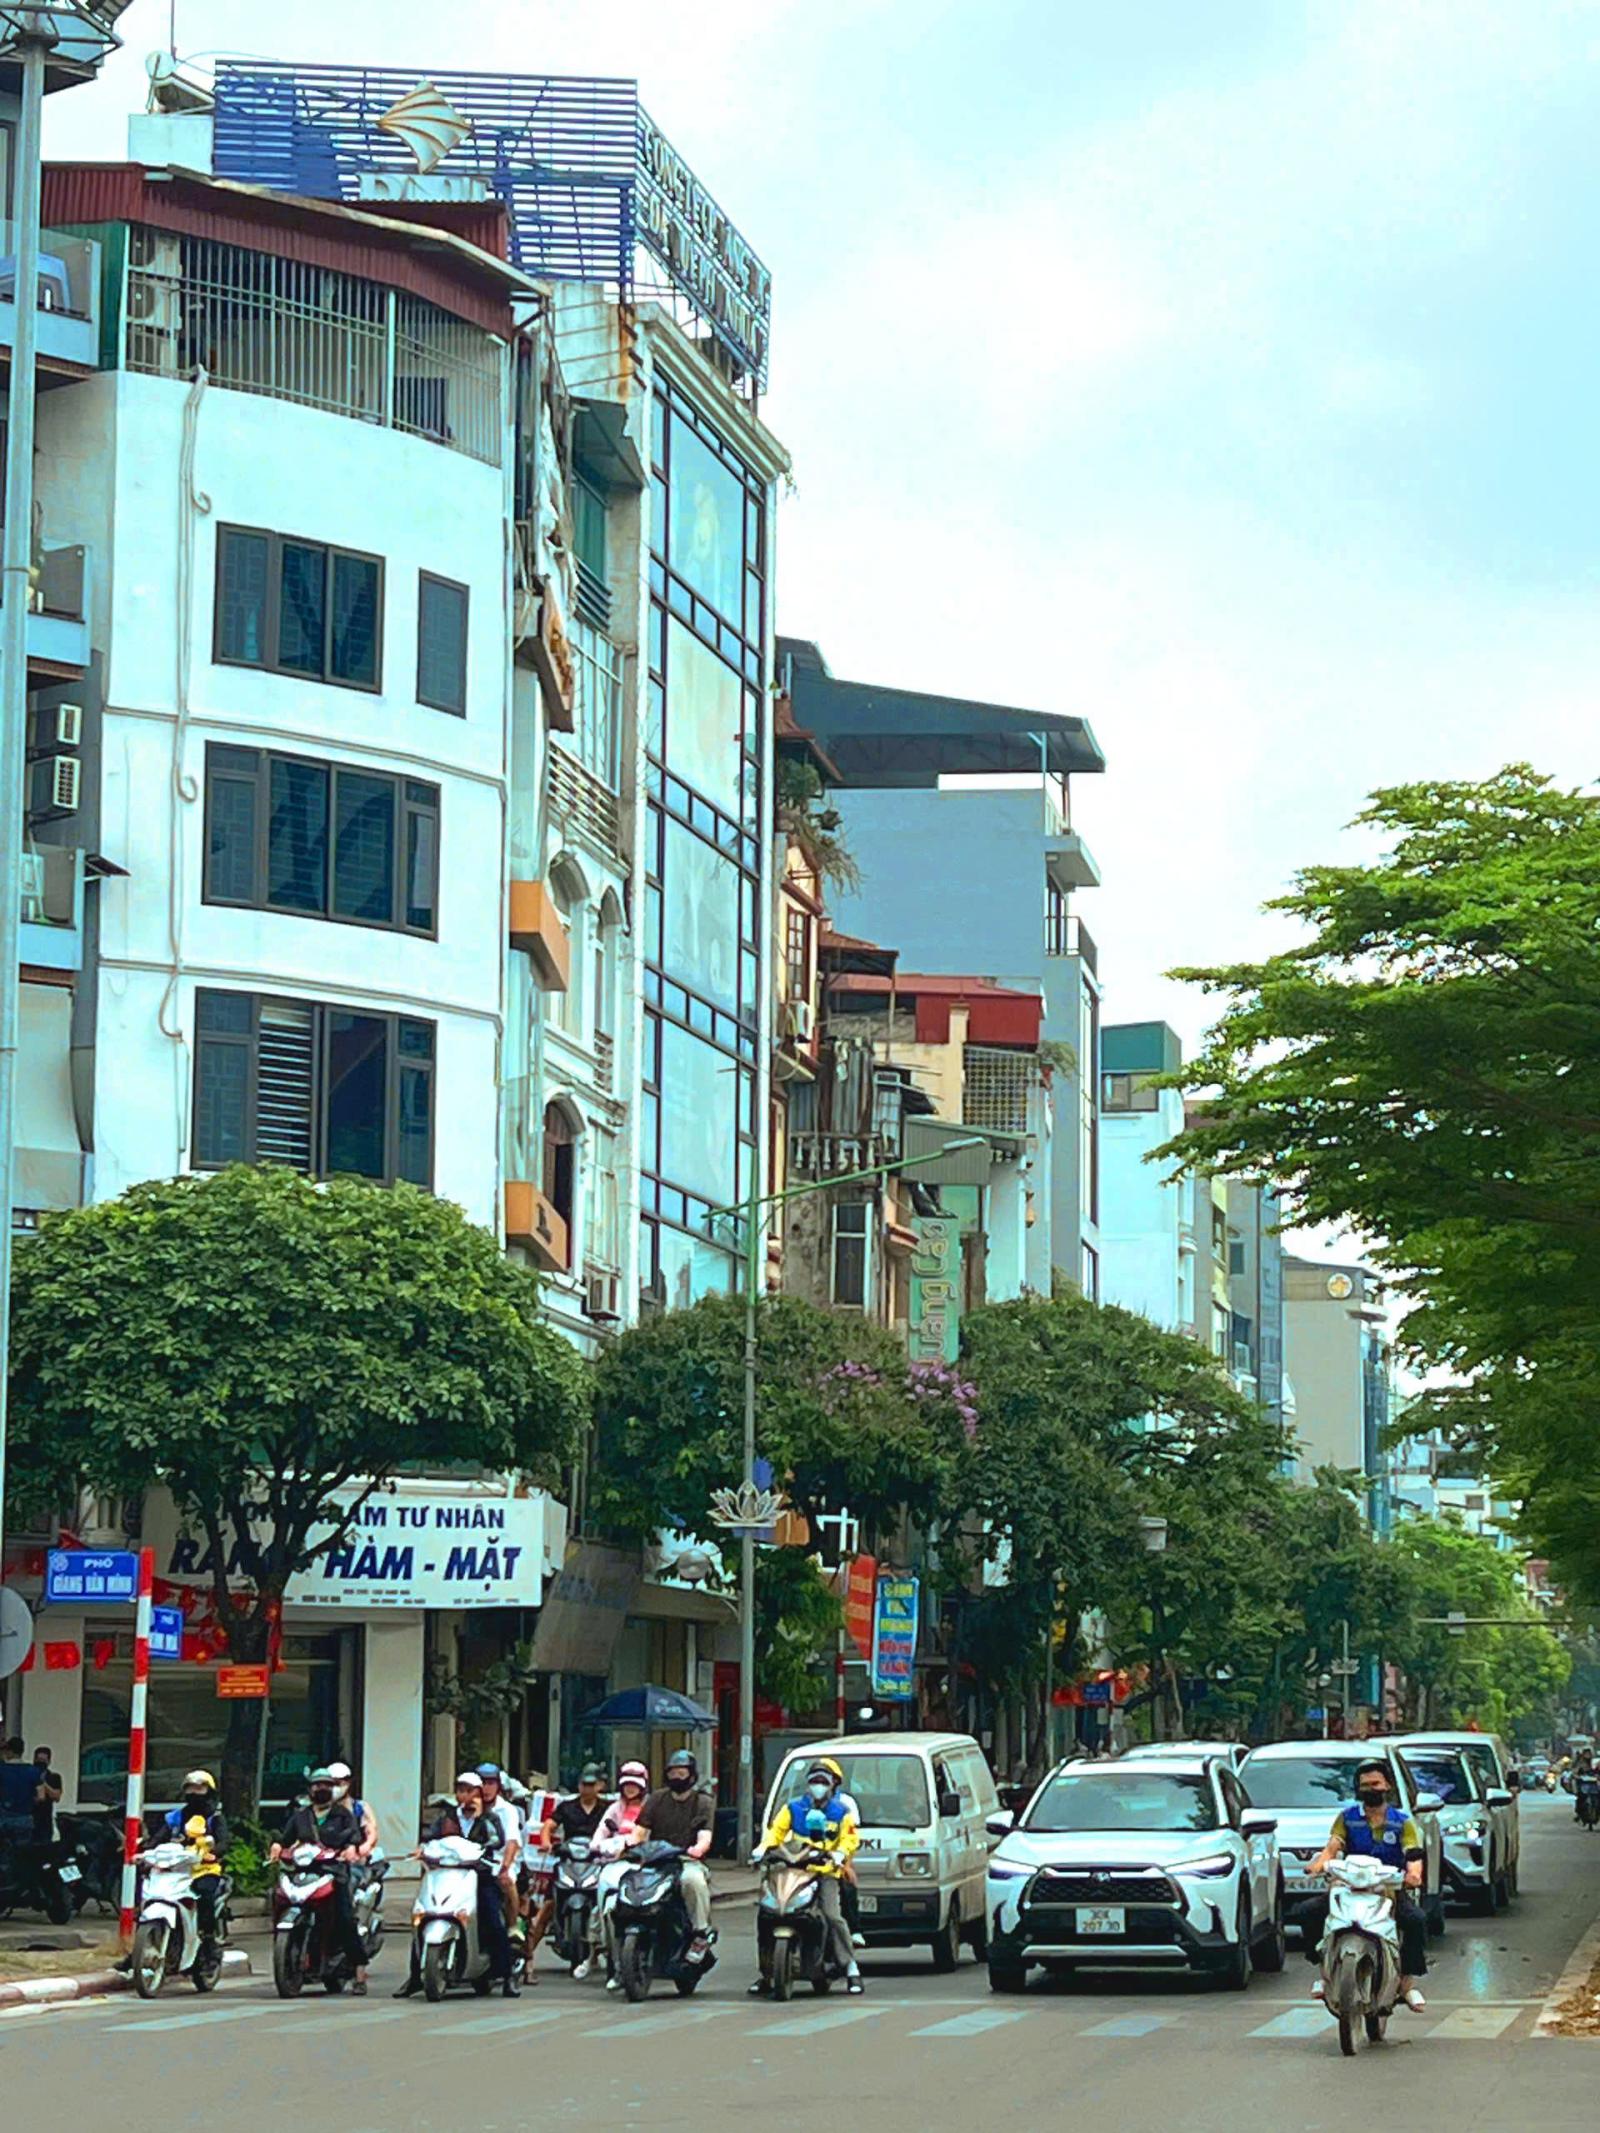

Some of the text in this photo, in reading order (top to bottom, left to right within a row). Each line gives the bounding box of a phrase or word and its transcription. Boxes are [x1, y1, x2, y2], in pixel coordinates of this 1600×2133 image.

[396, 1506, 430, 1528] TƯ
[436, 1503, 505, 1529] NHÂN
[444, 1536, 522, 1591] MẶT
